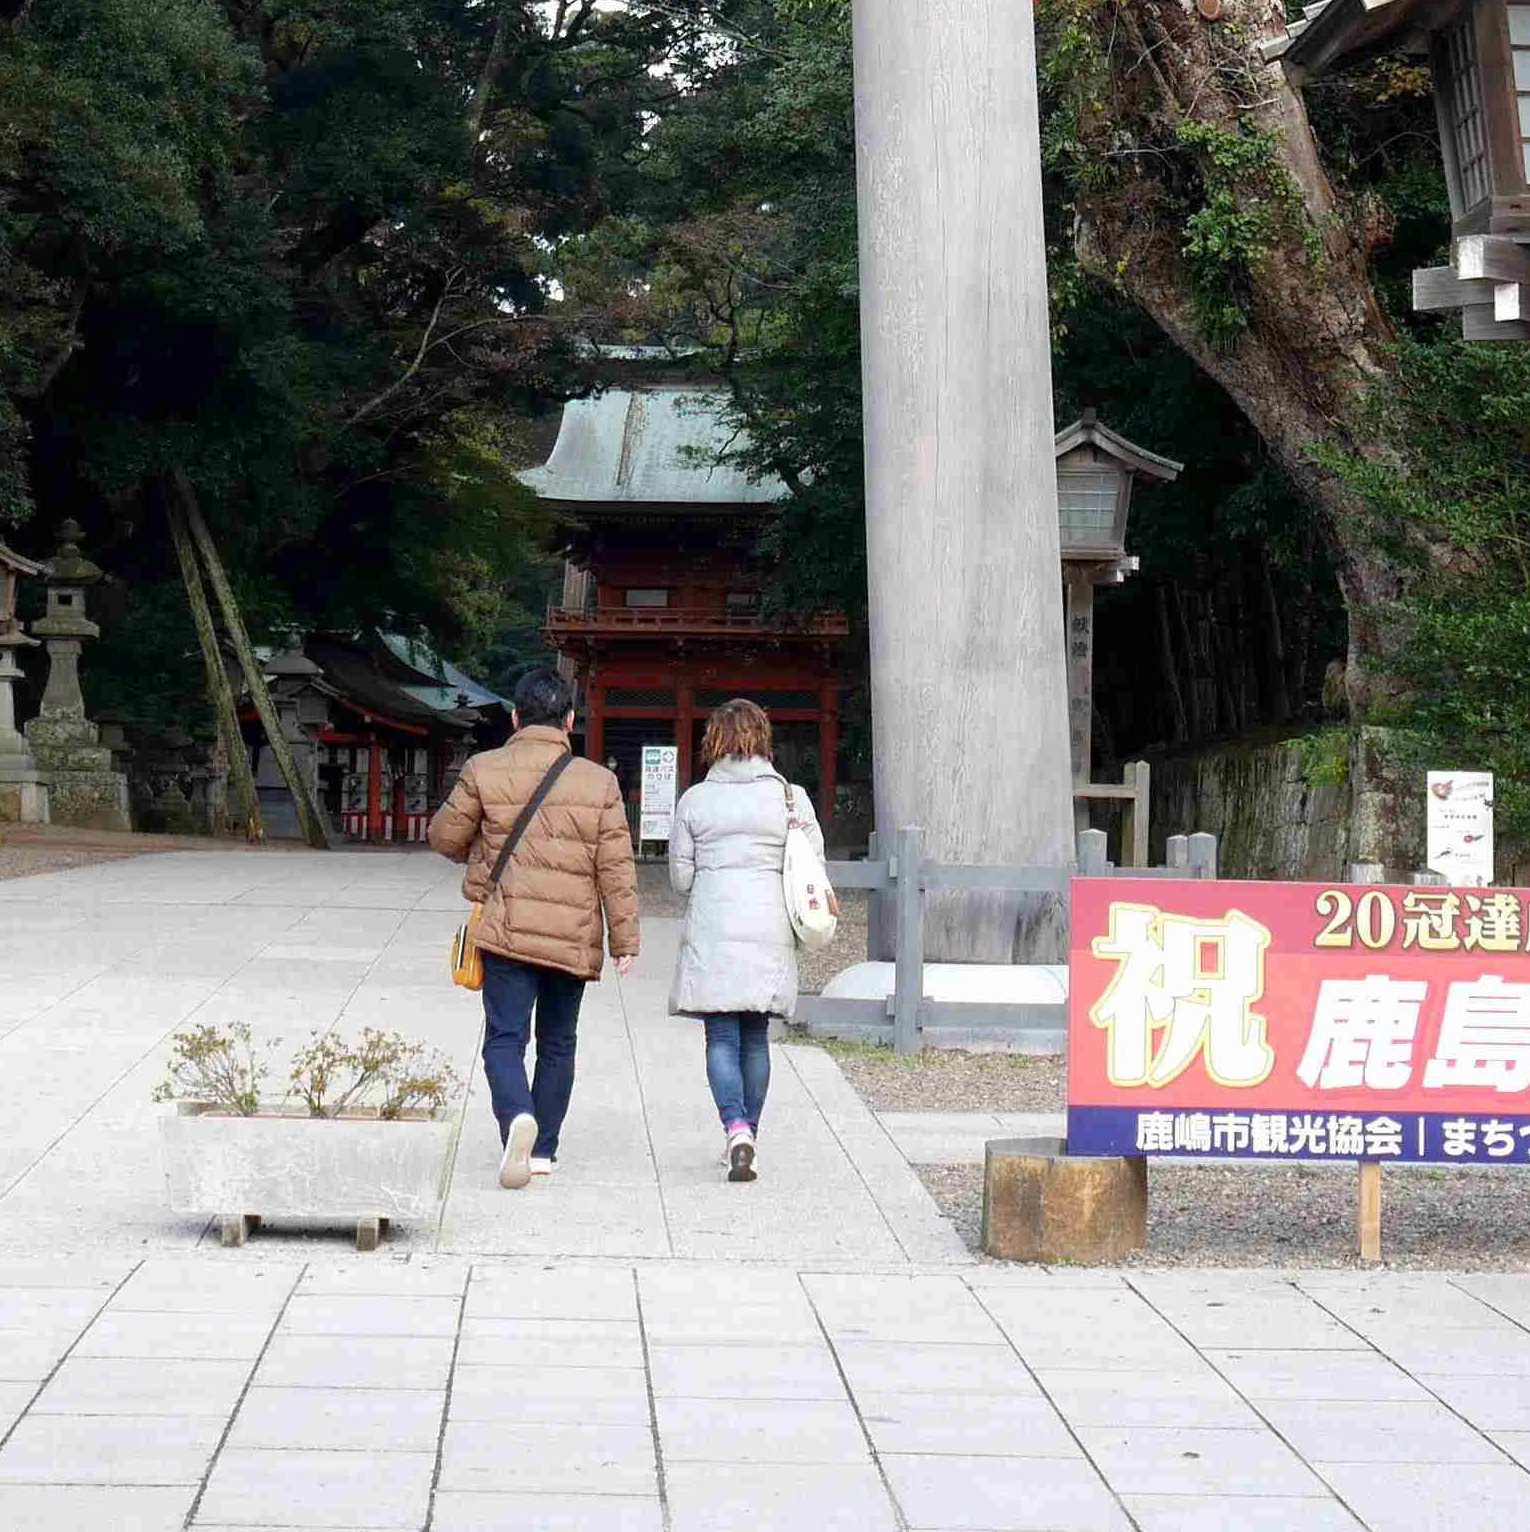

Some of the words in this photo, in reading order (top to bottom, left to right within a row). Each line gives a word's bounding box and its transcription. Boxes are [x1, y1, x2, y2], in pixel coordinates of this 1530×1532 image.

[1091, 902, 1274, 1088] 祝
[1135, 1113, 1403, 1156] 鹿嶋市観光協会
